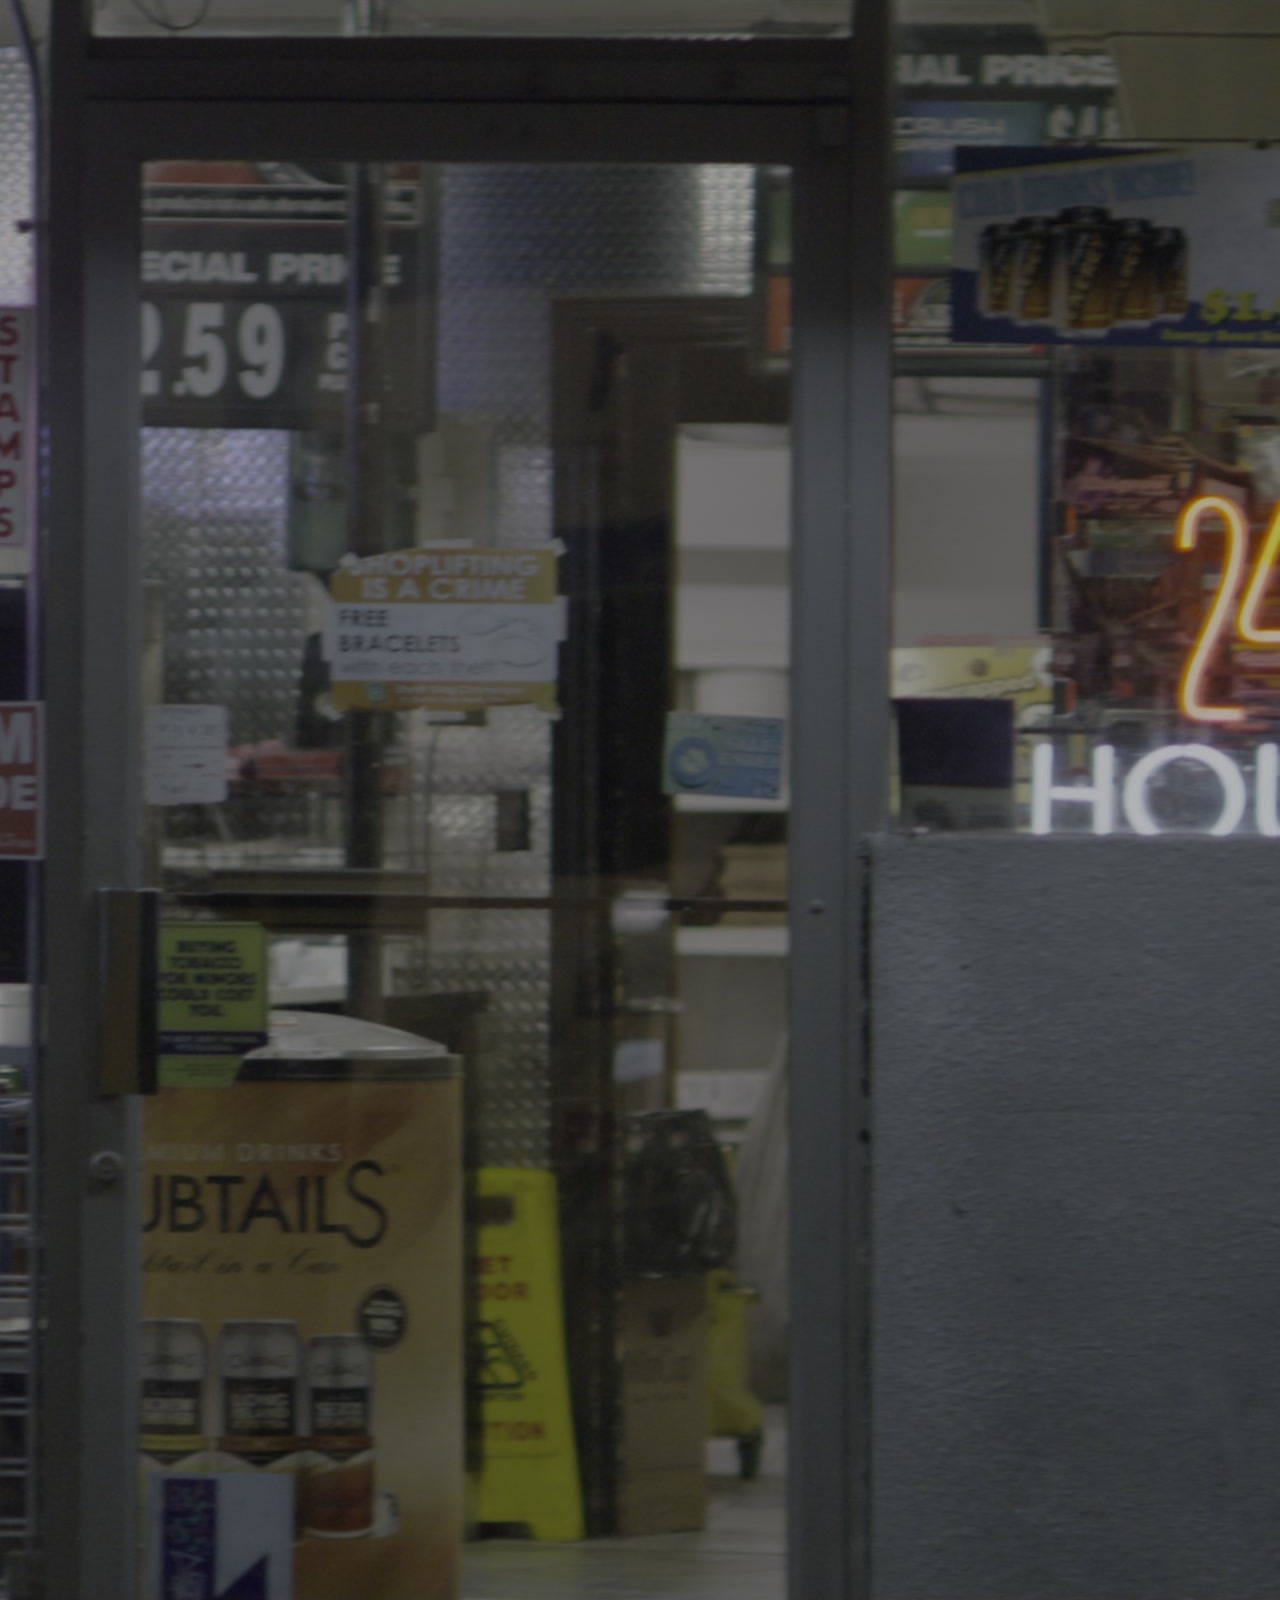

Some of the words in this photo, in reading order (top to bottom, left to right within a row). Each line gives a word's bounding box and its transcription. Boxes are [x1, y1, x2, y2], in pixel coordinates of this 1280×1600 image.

[266, 252, 404, 287] PRIE
[361, 578, 389, 600] IS
[395, 578, 422, 600] A
[428, 578, 527, 600] CRIME
[339, 609, 389, 628] FREE
[338, 634, 462, 653] BRACELETS
[236, 1142, 343, 1163] DRINKS
